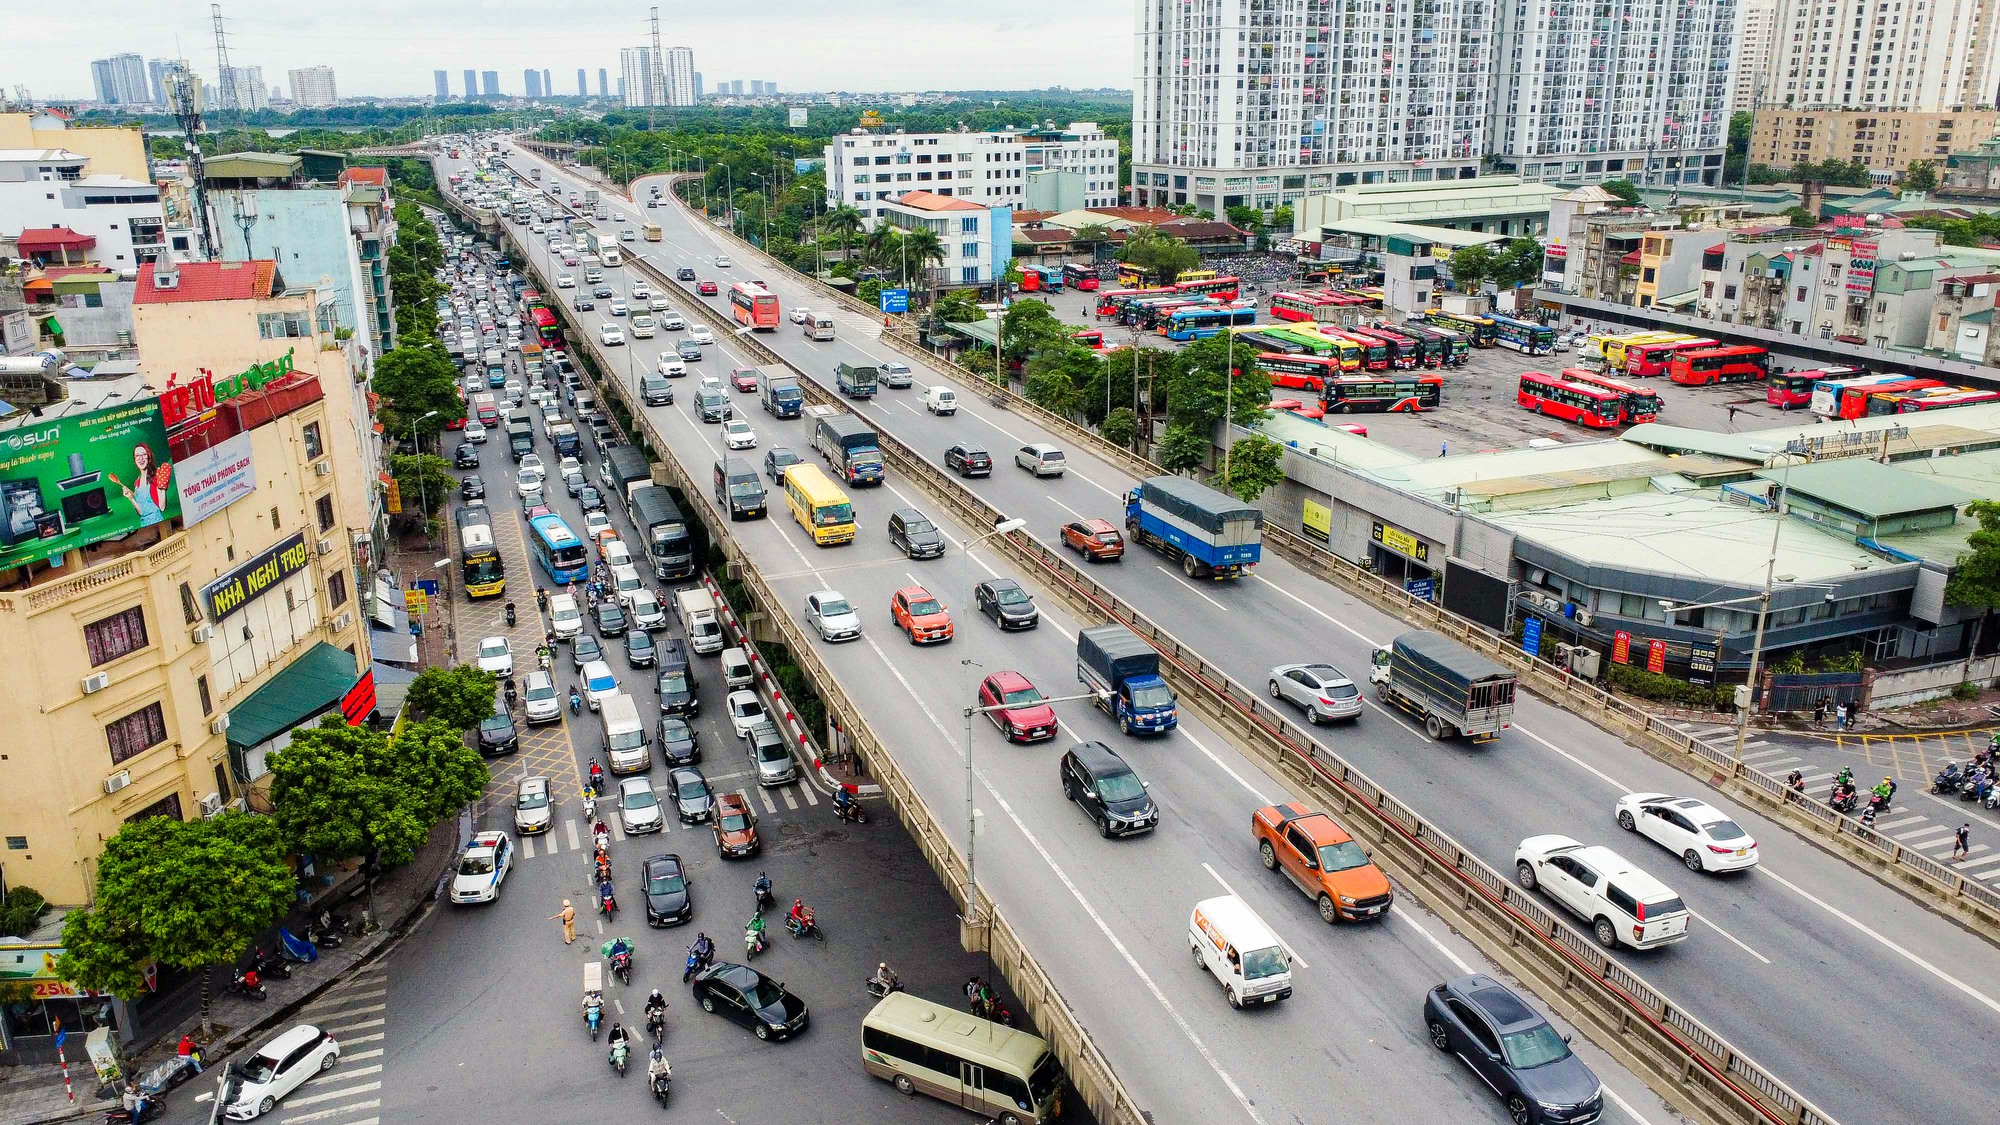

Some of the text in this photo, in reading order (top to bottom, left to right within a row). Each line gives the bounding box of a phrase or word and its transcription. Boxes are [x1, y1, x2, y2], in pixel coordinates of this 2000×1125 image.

[159, 372, 189, 427] BẾP
[190, 367, 215, 412] TỪ
[214, 353, 295, 403] eurosun
[183, 482, 201, 498] TỔNG
[201, 473, 217, 489] THẦU
[217, 469, 236, 481] PHÒNG
[236, 456, 250, 472] SẠCH
[214, 542, 306, 616] NHÀ NGHỈ TRỌ
